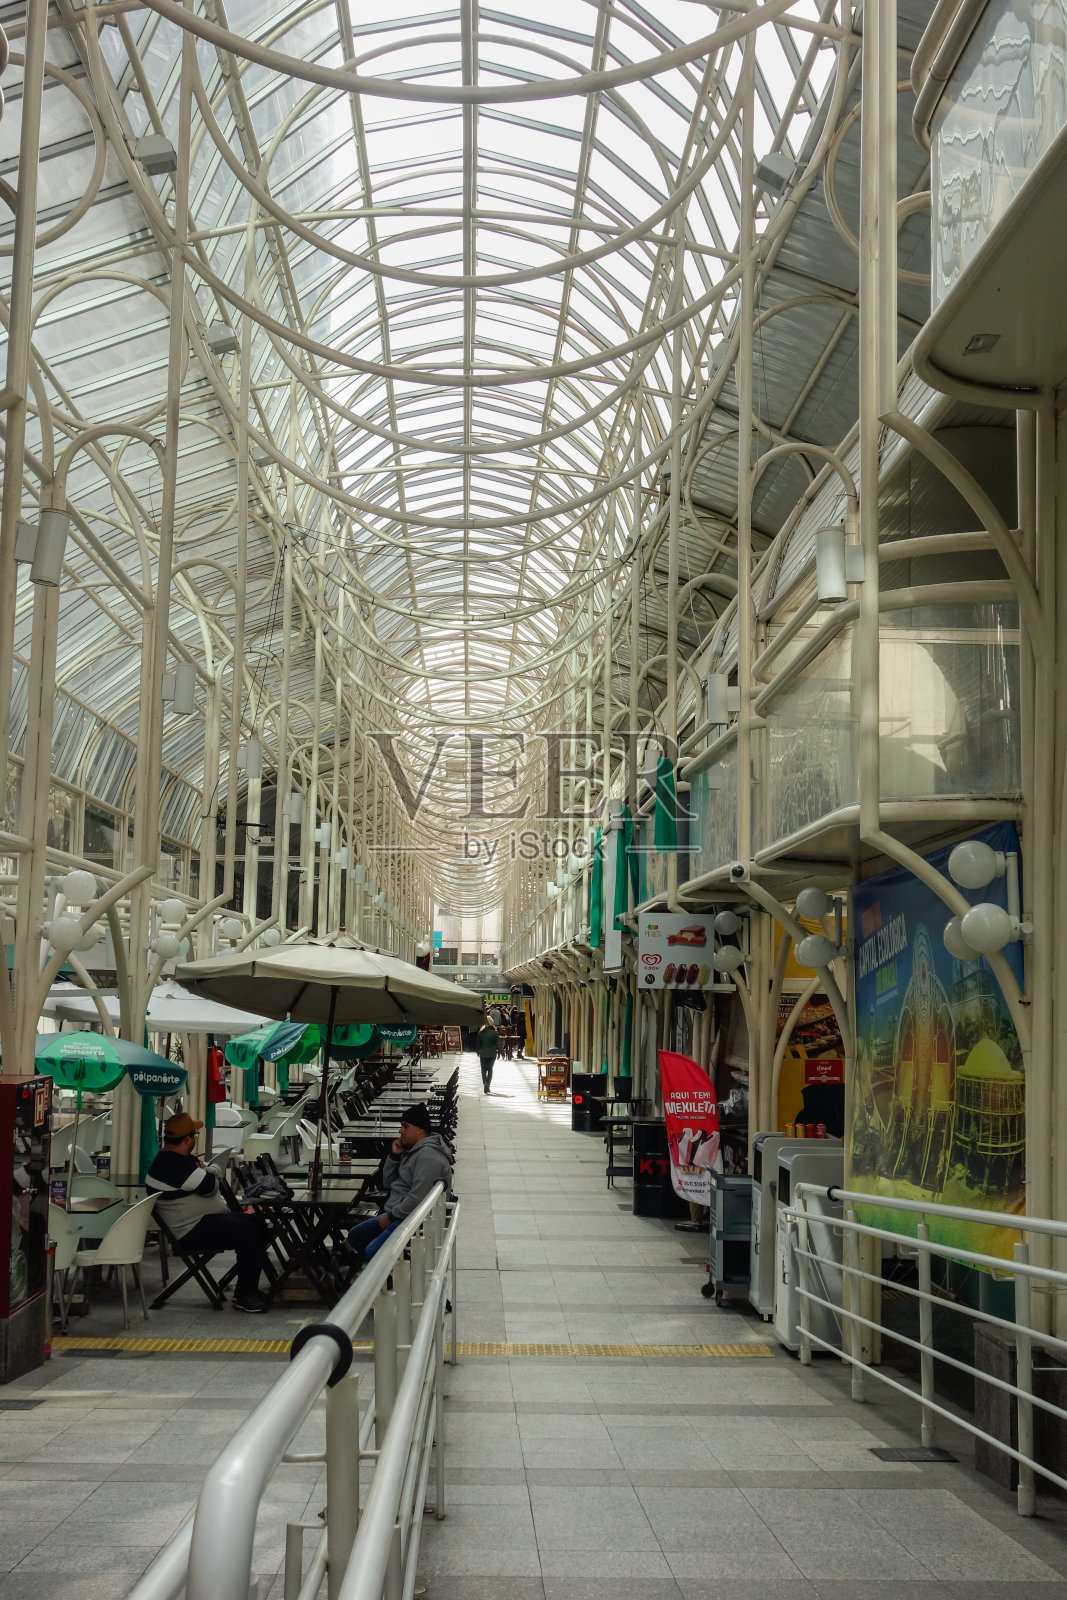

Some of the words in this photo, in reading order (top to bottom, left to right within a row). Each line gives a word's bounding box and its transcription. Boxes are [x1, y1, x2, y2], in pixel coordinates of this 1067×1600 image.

[670, 1091, 689, 1100] AQUI
[692, 1091, 711, 1099] TEM!
[664, 1100, 716, 1116] MEXILETA
